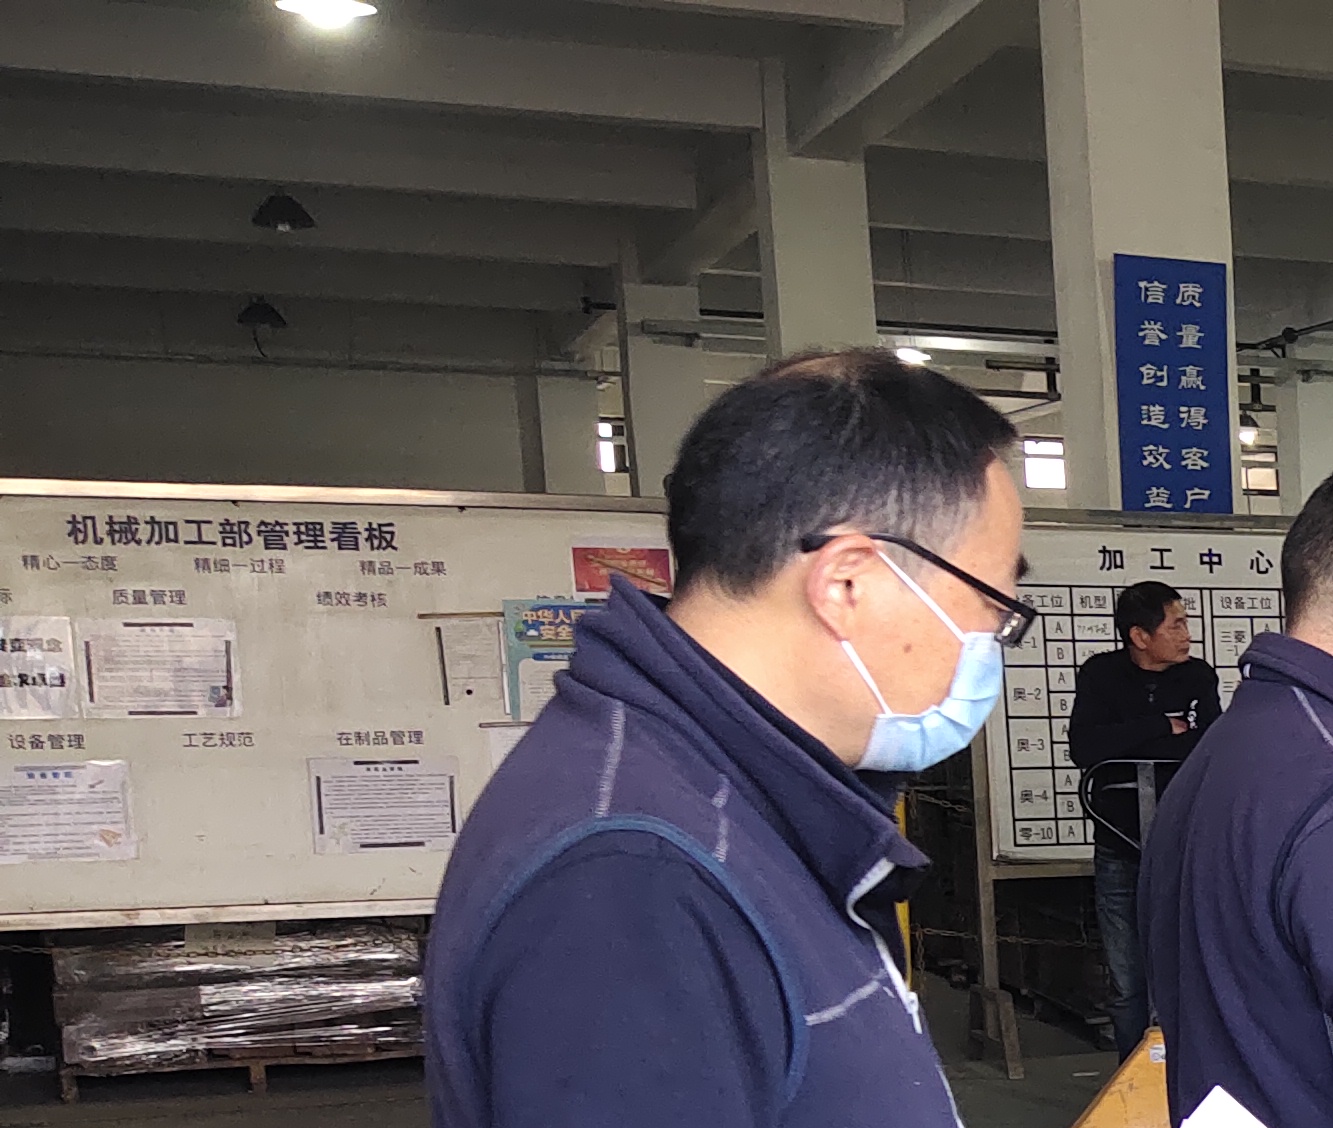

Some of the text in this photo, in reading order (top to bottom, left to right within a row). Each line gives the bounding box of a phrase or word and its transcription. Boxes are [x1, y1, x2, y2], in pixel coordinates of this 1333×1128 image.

[1137, 280, 1173, 509] 信誉创造效益
[1175, 283, 1210, 509] 质量赢得客户
[66, 514, 398, 551] 机械加工部管理看板
[1098, 546, 1274, 574] 加工中心
[112, 589, 188, 605] 质量管理
[316, 591, 388, 607] 绩效考核
[1019, 593, 1064, 608] 备工位
[1079, 595, 1107, 609] 机型
[1220, 597, 1273, 610] 设备工位
[1055, 622, 1063, 634] A
[1058, 672, 1065, 684] A
[1013, 687, 1041, 700] 奥-2
[1060, 699, 1067, 711] B
[8, 733, 86, 750] 设备管理
[182, 732, 255, 748] 工艺规范
[336, 731, 424, 746] 在制品管理
[1017, 737, 1045, 751] 奥-3
[1065, 775, 1072, 786] A
[1020, 789, 1049, 803] 奥-4
[1067, 825, 1075, 837] A
